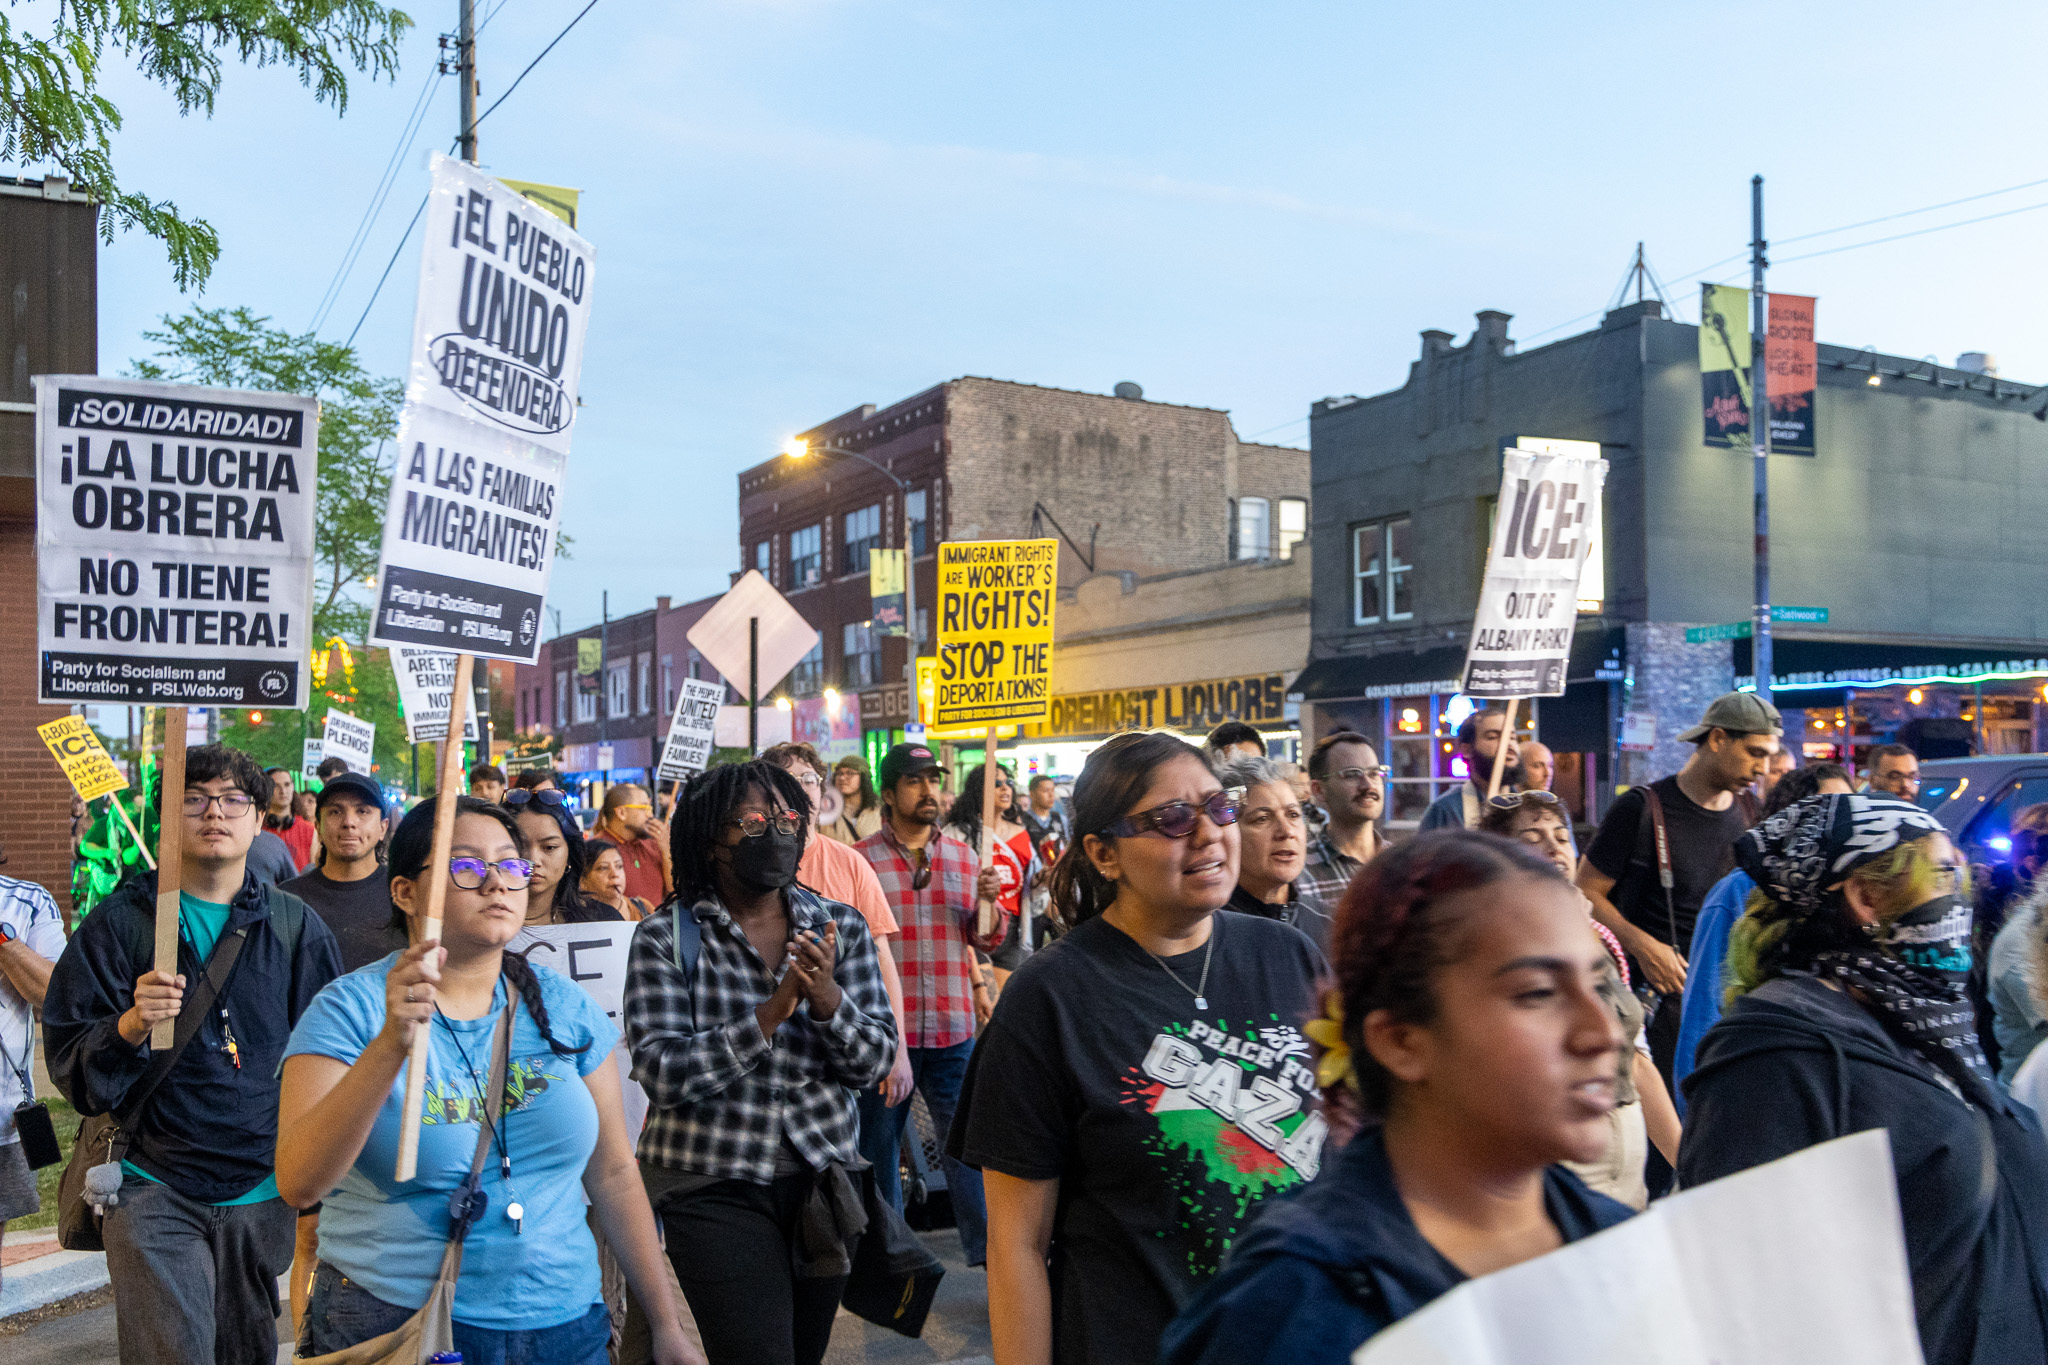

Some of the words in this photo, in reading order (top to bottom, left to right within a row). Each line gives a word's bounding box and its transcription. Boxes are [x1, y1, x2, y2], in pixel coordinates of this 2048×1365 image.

[451, 187, 497, 255] ¡EL
[504, 210, 585, 305] PUEBLO
[459, 253, 569, 378] UNIDO
[70, 399, 293, 440] ¡SOLIDARIDAD!
[61, 436, 136, 485] ¡LA
[151, 443, 300, 494] LUCHA
[408, 441, 427, 484] A
[434, 447, 476, 496] LAS
[480, 461, 555, 521] FAMILIAS
[72, 483, 284, 542] OBRERA
[400, 489, 549, 572] MIGRANTES!
[944, 546, 1011, 564] IMMIGRANT
[1015, 545, 1053, 563] RIGHTS
[79, 557, 140, 597] NO
[152, 562, 270, 603] TIENE
[945, 571, 963, 585] ARE
[54, 603, 289, 648] FRONTERA!
[943, 588, 1050, 632] RIGHTS!
[1505, 592, 1535, 619] OUT
[1475, 628, 1530, 652] ALBANY
[1532, 627, 1569, 651] PARK!
[52, 660, 94, 679] Party
[96, 661, 118, 677] for
[121, 664, 193, 681] Socialism
[198, 667, 226, 682] and
[408, 658, 437, 673] ARE
[416, 673, 455, 688] ENEM
[940, 640, 1004, 681] STOP
[1013, 643, 1049, 676] THE
[52, 678, 130, 695] Liberation
[152, 682, 244, 701] PSLWeb.org
[681, 697, 717, 720] UNITED
[940, 678, 1047, 706] DEPORTATIONS!
[1036, 690, 1158, 735] OREMOST
[1165, 677, 1285, 728] LIQUORS
[51, 733, 100, 760] ICE
[327, 728, 369, 754] PLENOS
[1187, 1019, 1277, 1069] PEACE
[1141, 1033, 1329, 1182] GAZA
